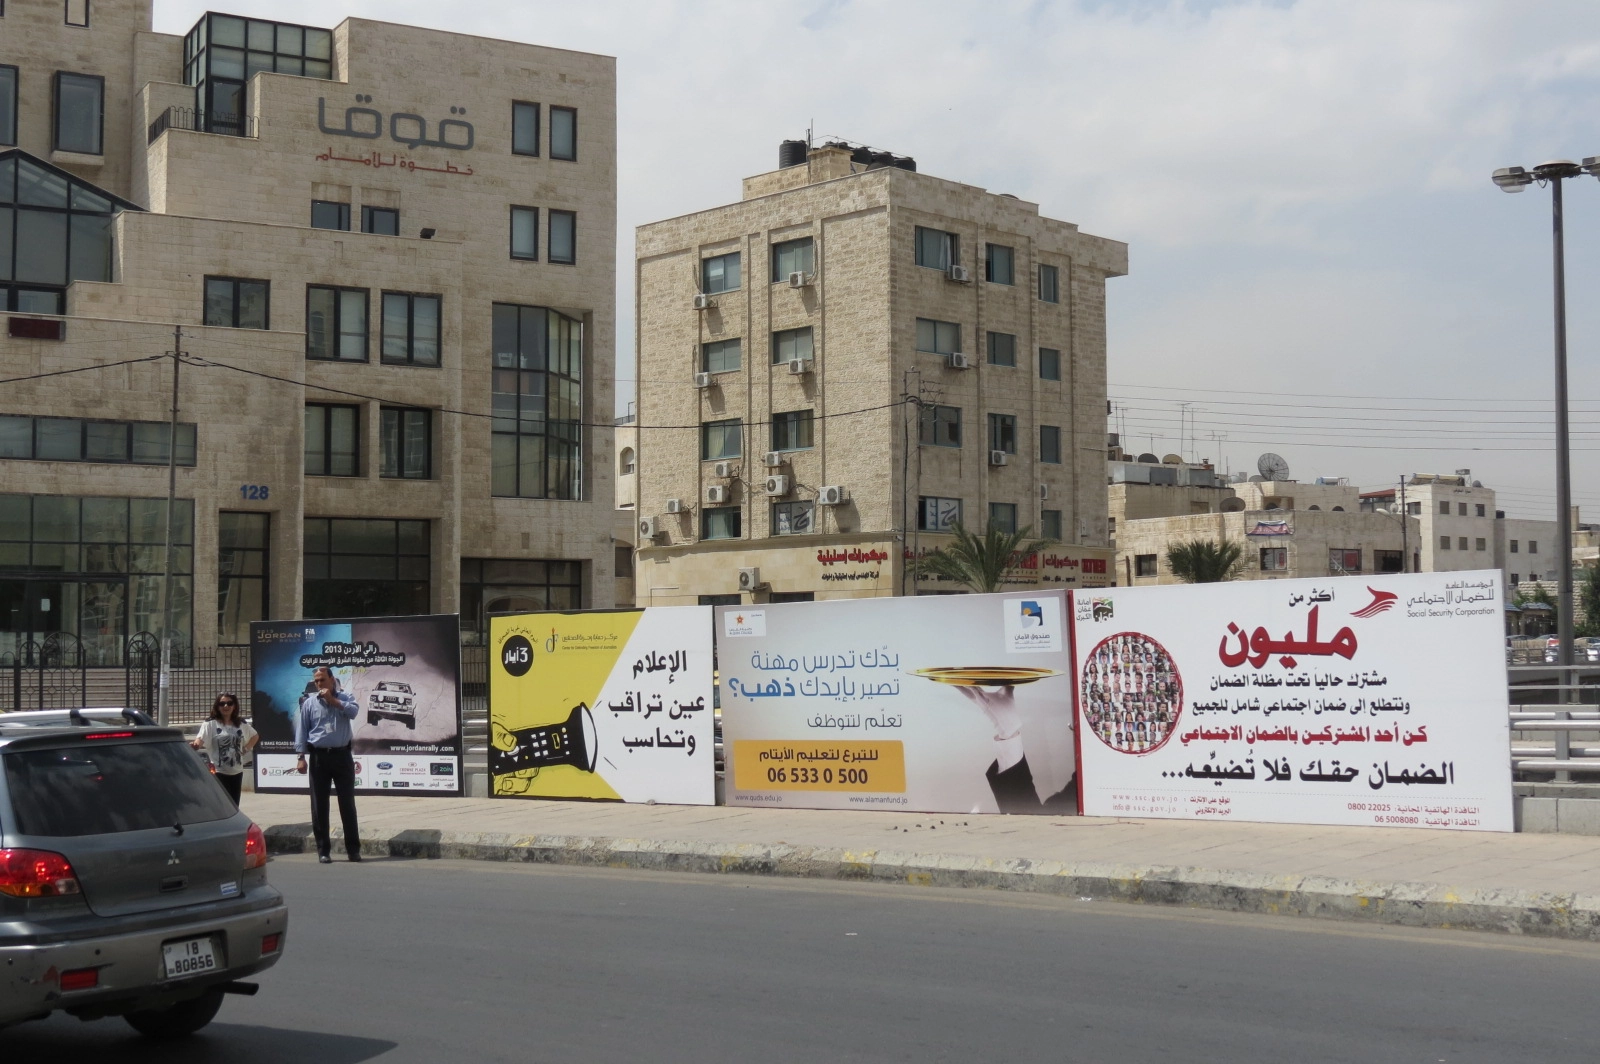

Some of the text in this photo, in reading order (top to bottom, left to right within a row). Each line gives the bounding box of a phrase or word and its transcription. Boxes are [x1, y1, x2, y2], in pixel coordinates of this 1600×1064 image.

[316, 147, 474, 176] خطوة للأمام
[241, 484, 269, 500] 128
[1446, 579, 1494, 589] المؤسسة العامة
[1289, 587, 1335, 606] أكثر من
[1407, 589, 1494, 608] للضمان الاجتماعي
[1408, 607, 1495, 618] Social Security Corporation
[1218, 604, 1358, 669] مليون
[324, 644, 377, 657] رالي الأردن 2013
[632, 650, 687, 684] الإعلام
[751, 650, 798, 672] مهنة
[803, 650, 855, 673] تدرس
[1210, 673, 1249, 691] الضمان
[1252, 672, 1282, 688] مظلة
[1286, 672, 1310, 688] تحت
[1347, 670, 1387, 689] مشترك
[800, 676, 856, 702] بإيدك
[860, 679, 900, 700] تصير
[608, 690, 705, 720] عين تراقب
[1192, 698, 1228, 716] للجميع
[1231, 697, 1260, 714] شامل
[1263, 698, 1311, 716] اجتماعي
[1314, 698, 1346, 715] ضمان
[1350, 698, 1366, 715] إلى
[806, 713, 861, 730] لتتوظف
[622, 727, 696, 756] وتحاسب
[1180, 722, 1428, 746] كن أحد المشتركين بالضمان الاجتماعي
[759, 747, 878, 764] للتبرع لتعليم الأيتام
[767, 767, 868, 784] 06 533 0 500
[1262, 756, 1292, 781] فلا
[1299, 758, 1359, 782] حقك
[1368, 760, 1454, 790] الضمان
[735, 794, 782, 802] www.quds.edu.jo
[849, 796, 908, 804] www.alamanfund.jo
[1424, 806, 1453, 815] الهاتفية
[186, 942, 199, 956] 18
[175, 954, 214, 974] 80856
